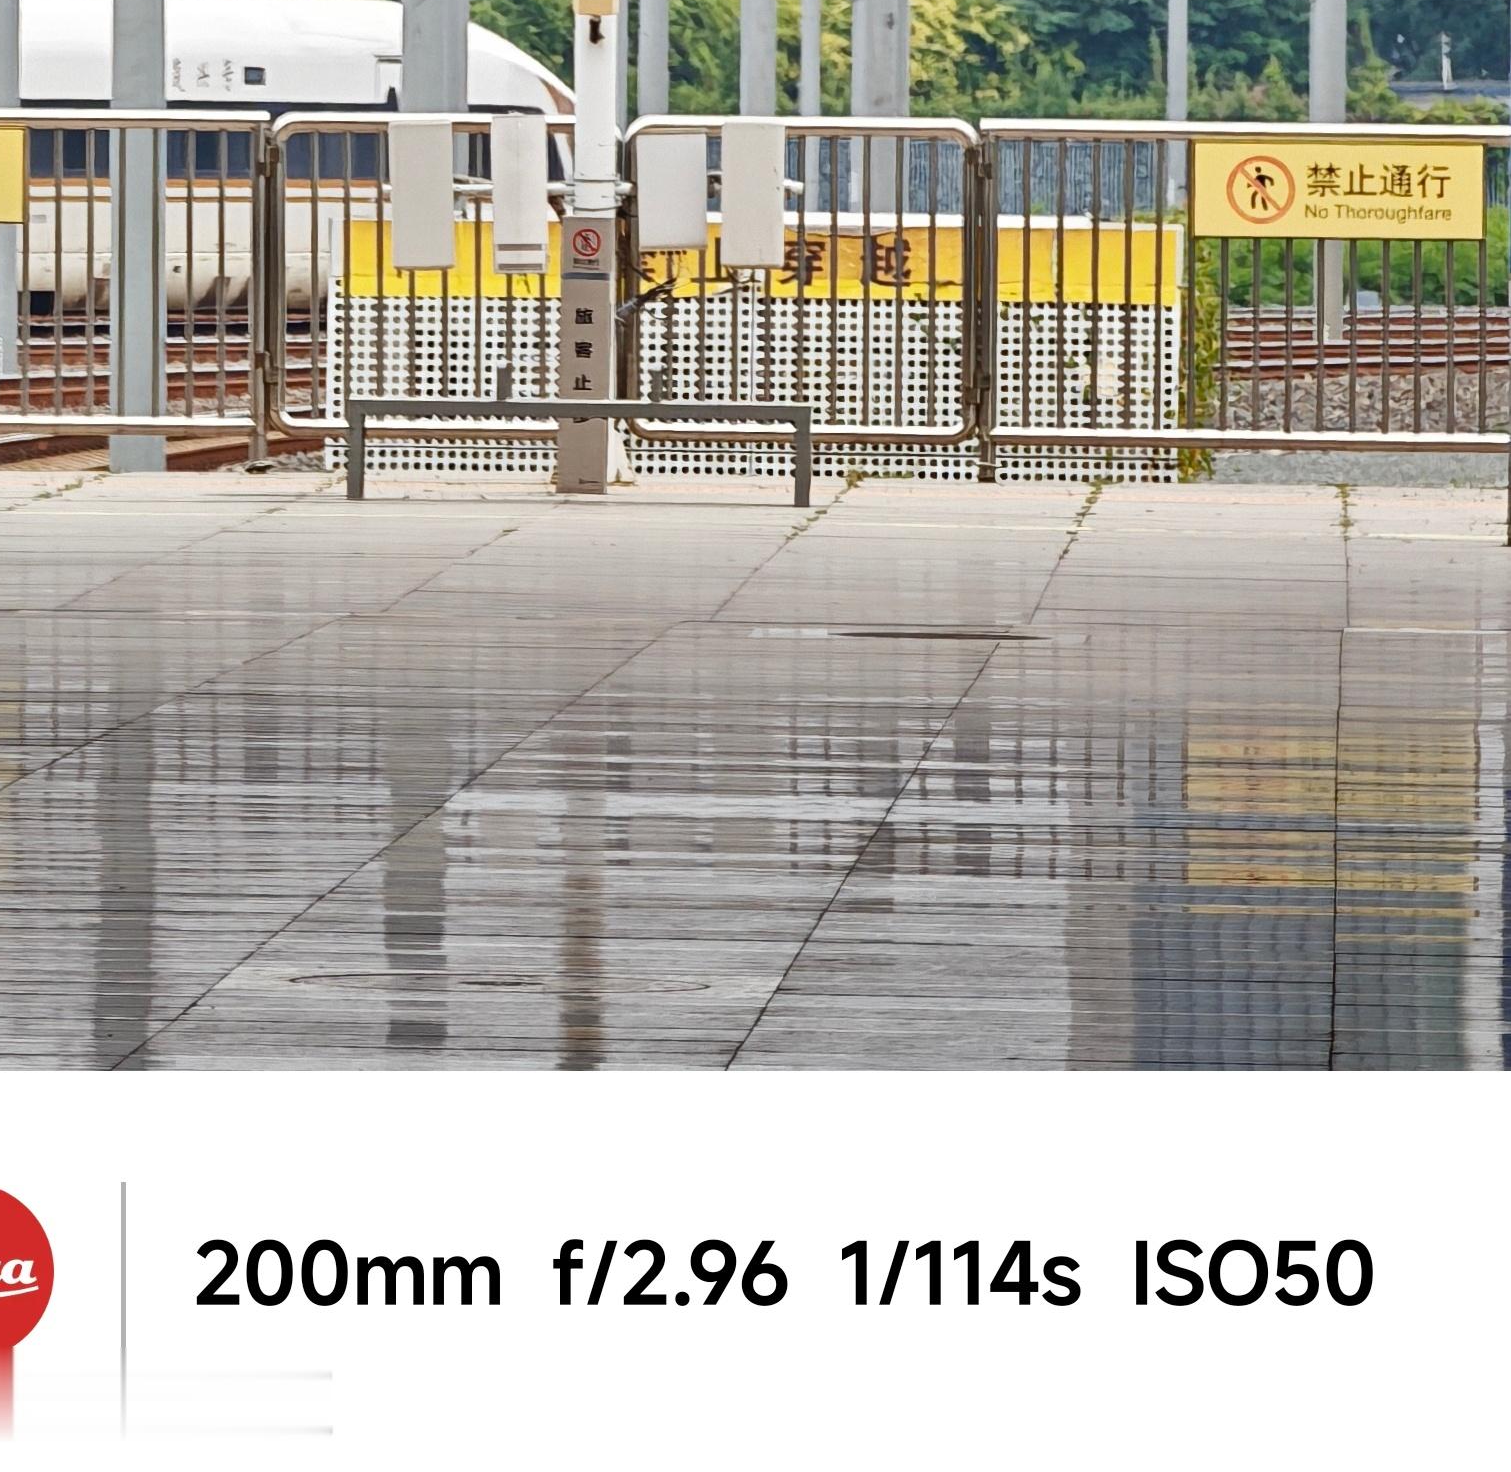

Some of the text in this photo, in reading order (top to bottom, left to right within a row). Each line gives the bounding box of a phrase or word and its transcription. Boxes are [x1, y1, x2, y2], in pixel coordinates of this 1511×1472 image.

[1305, 161, 1451, 199] 禁止通行
[1304, 204, 1452, 224] No Thoroughfare
